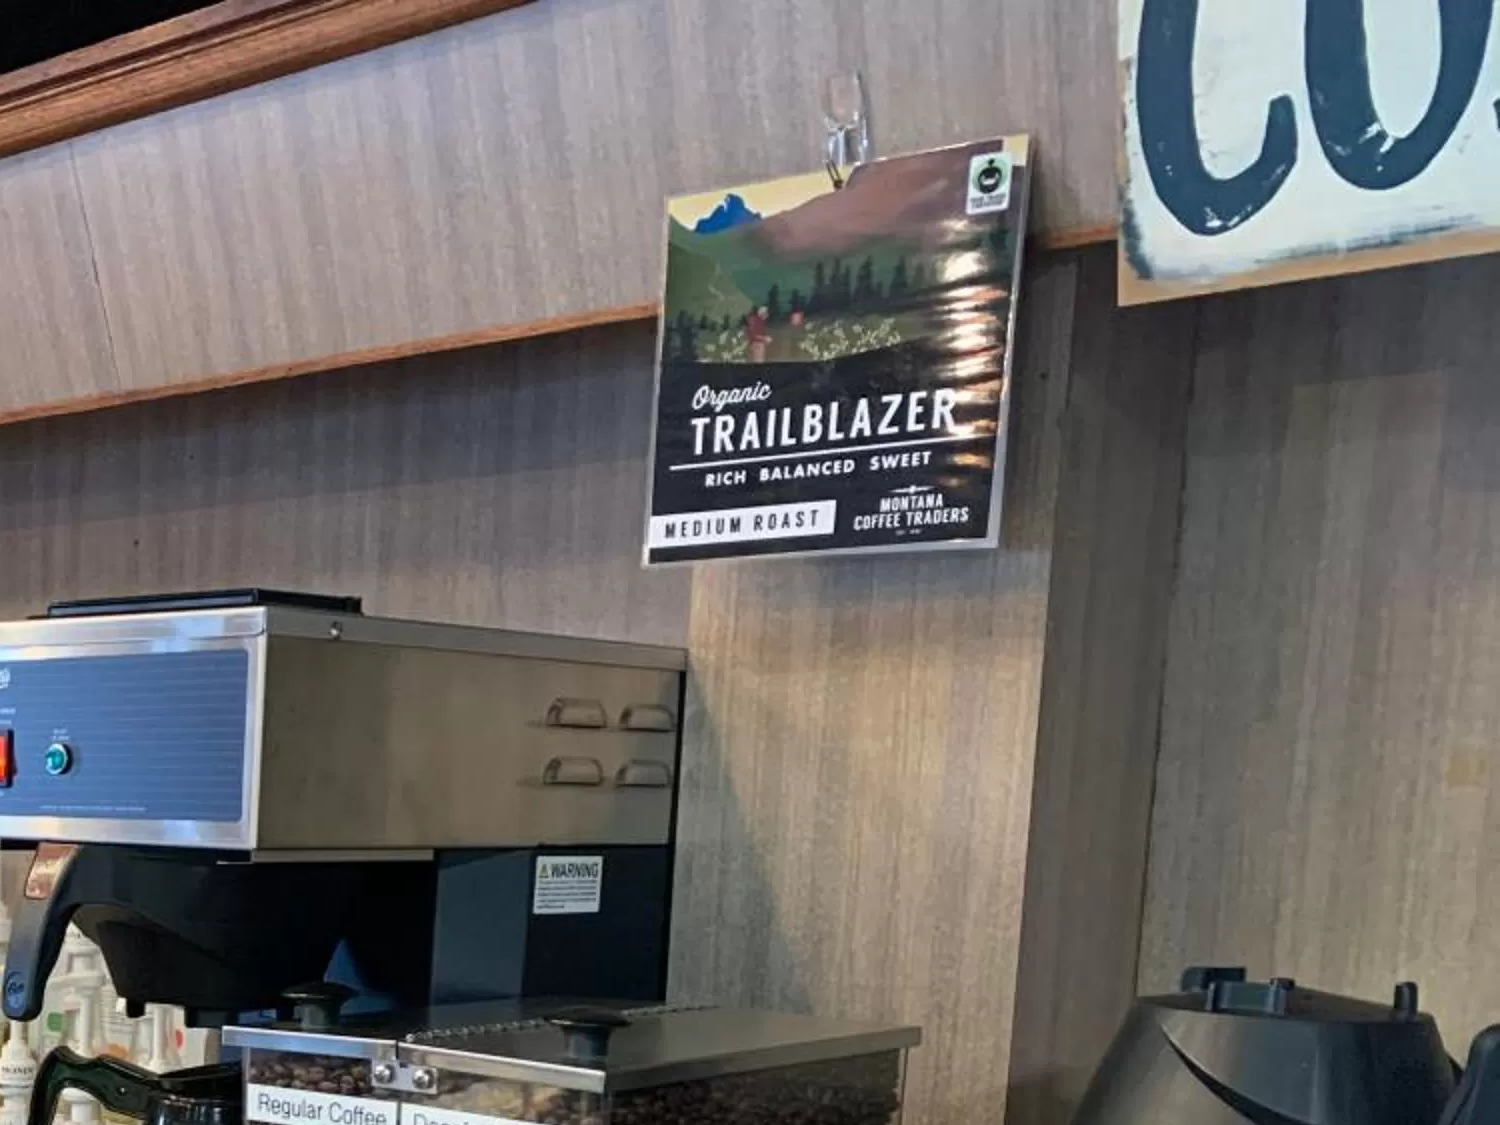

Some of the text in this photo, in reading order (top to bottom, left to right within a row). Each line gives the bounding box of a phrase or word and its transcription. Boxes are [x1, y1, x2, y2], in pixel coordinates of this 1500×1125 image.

[692, 380, 772, 413] Organic
[690, 388, 960, 455] TRAILBLAZER
[704, 451, 932, 487] RICH BALANCED SWEET
[879, 493, 944, 512] MONTANA
[664, 509, 820, 540] MEDIUM ROAST
[853, 506, 969, 532] COFFEE TRADERS
[257, 1092, 322, 1122] Regular
